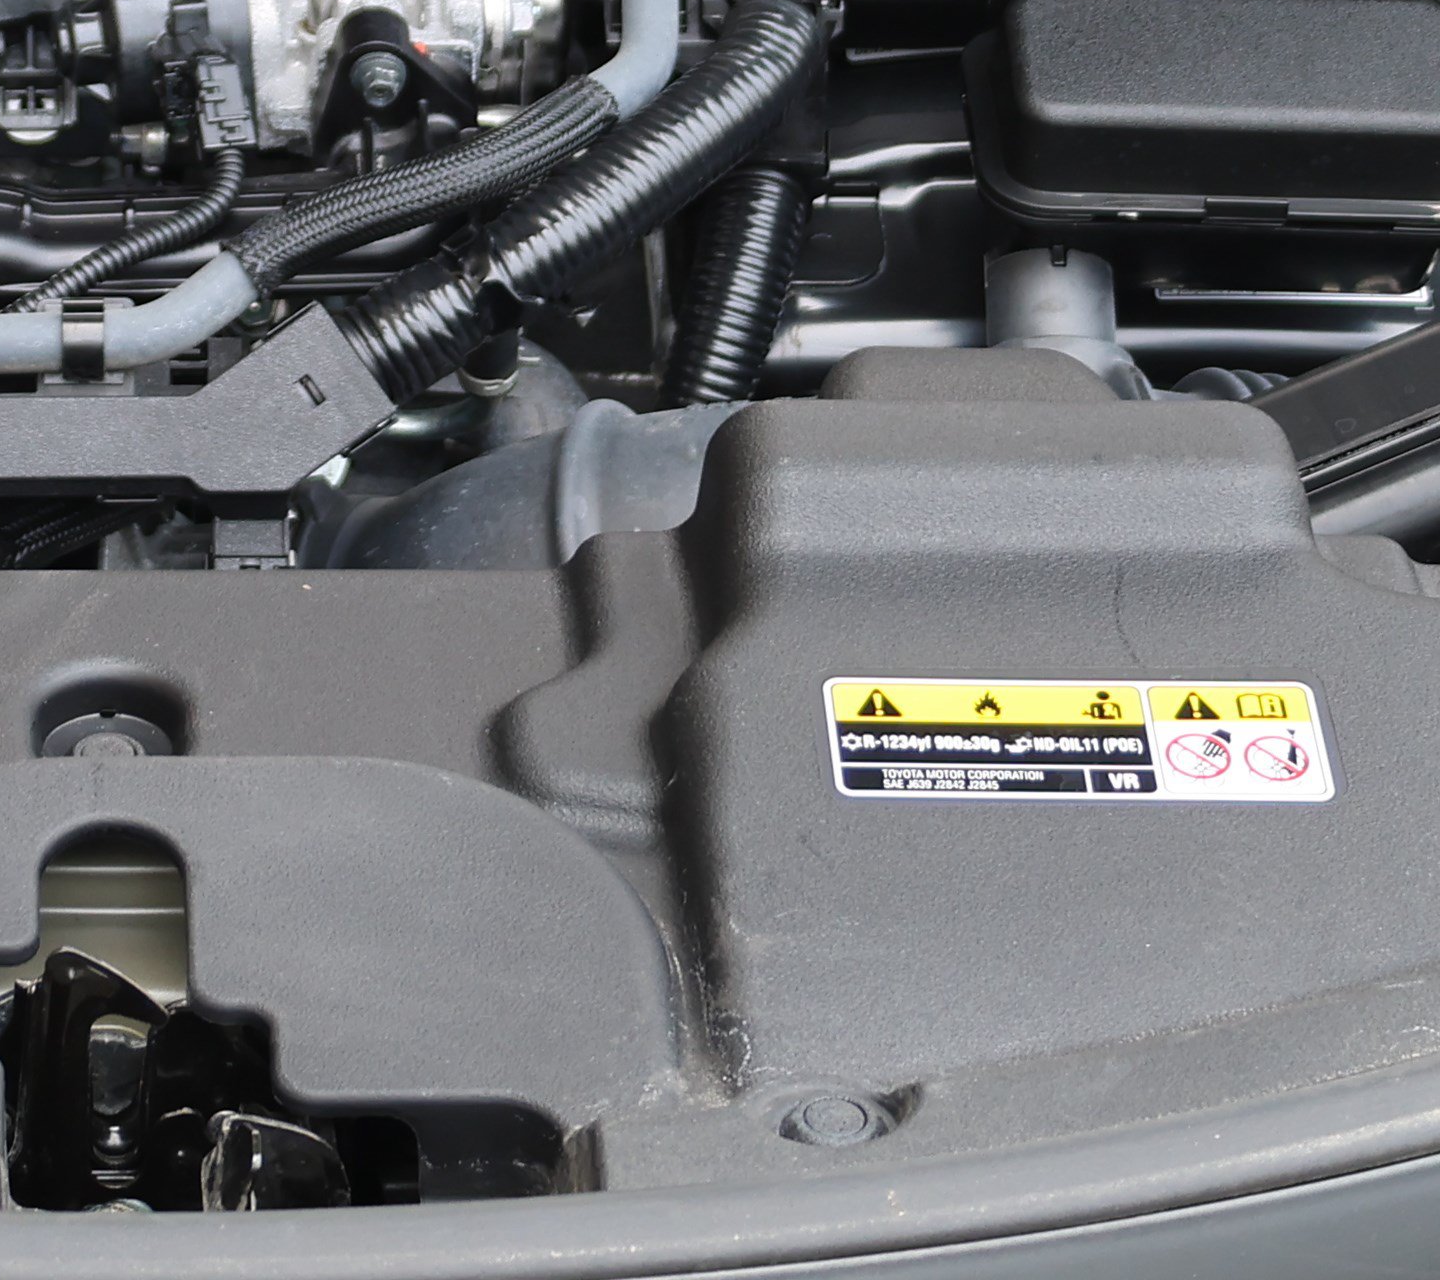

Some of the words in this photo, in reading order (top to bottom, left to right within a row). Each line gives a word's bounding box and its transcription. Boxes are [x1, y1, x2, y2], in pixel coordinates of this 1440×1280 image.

[1033, 736, 1100, 752] ND-OIL11
[1103, 737, 1144, 755] (POE)
[882, 768, 924, 780] TOYOTA
[926, 769, 965, 780] MOTOR
[967, 769, 1044, 781] CORPORATION
[1108, 772, 1140, 789] VR
[883, 779, 904, 790] SAE
[906, 780, 932, 790] J639
